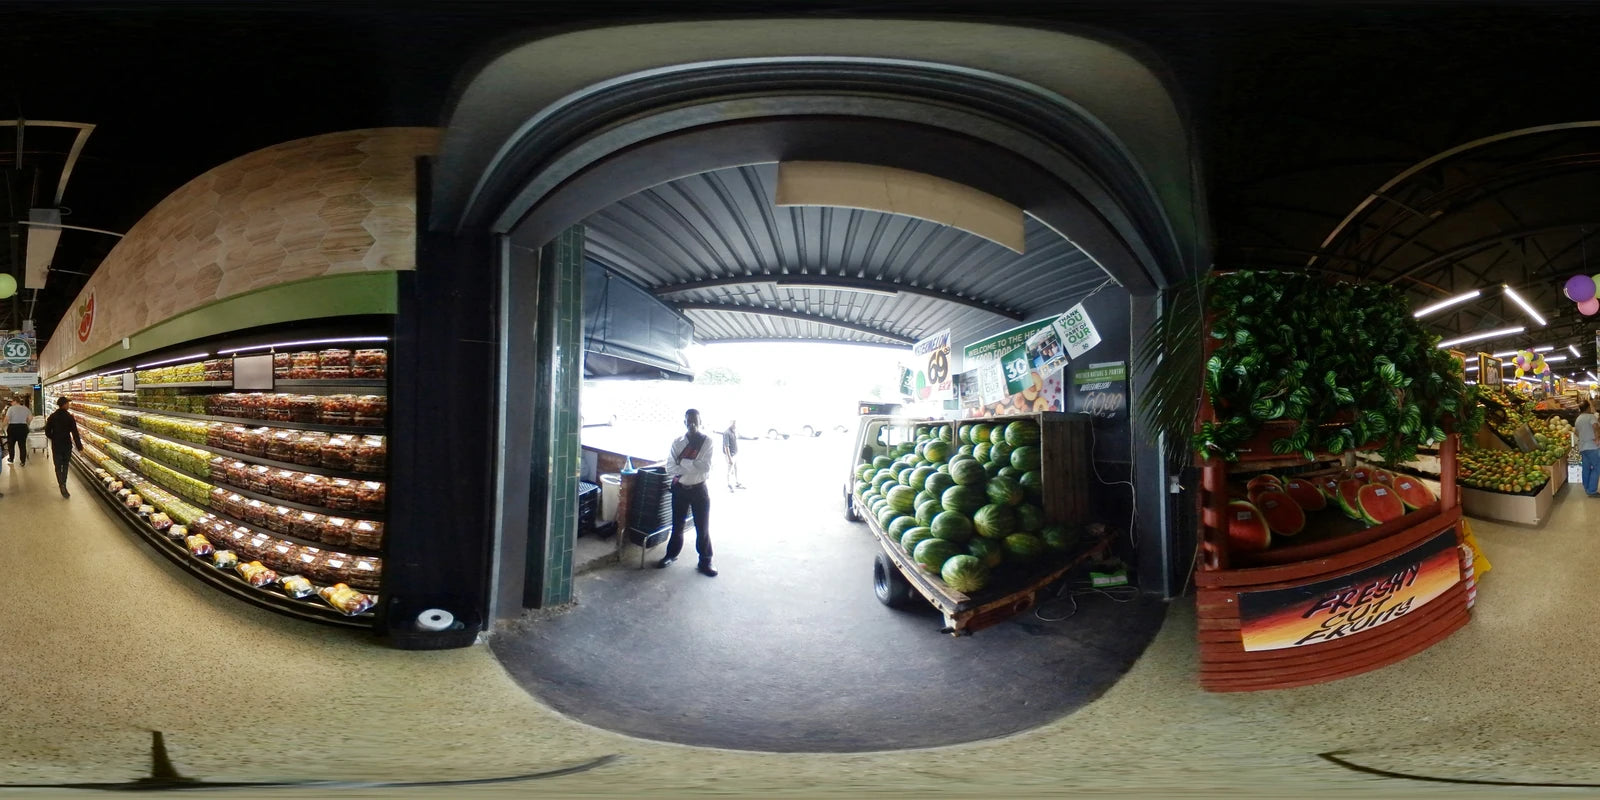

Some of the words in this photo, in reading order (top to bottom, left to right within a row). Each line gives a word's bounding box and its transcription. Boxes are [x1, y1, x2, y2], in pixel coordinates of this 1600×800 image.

[1058, 309, 1079, 324] THANK
[1060, 313, 1083, 329] YOU
[1065, 328, 1080, 338] PART
[1068, 327, 1091, 344] OUR
[7, 344, 27, 357] 30
[967, 342, 997, 357] WELCOME
[997, 339, 1007, 348] TO
[1008, 333, 1024, 345] THE
[1006, 357, 1027, 379] 30
[1302, 561, 1422, 619] FRESHY
[1294, 596, 1416, 645] FRUITS
[1320, 594, 1393, 629] CUT
